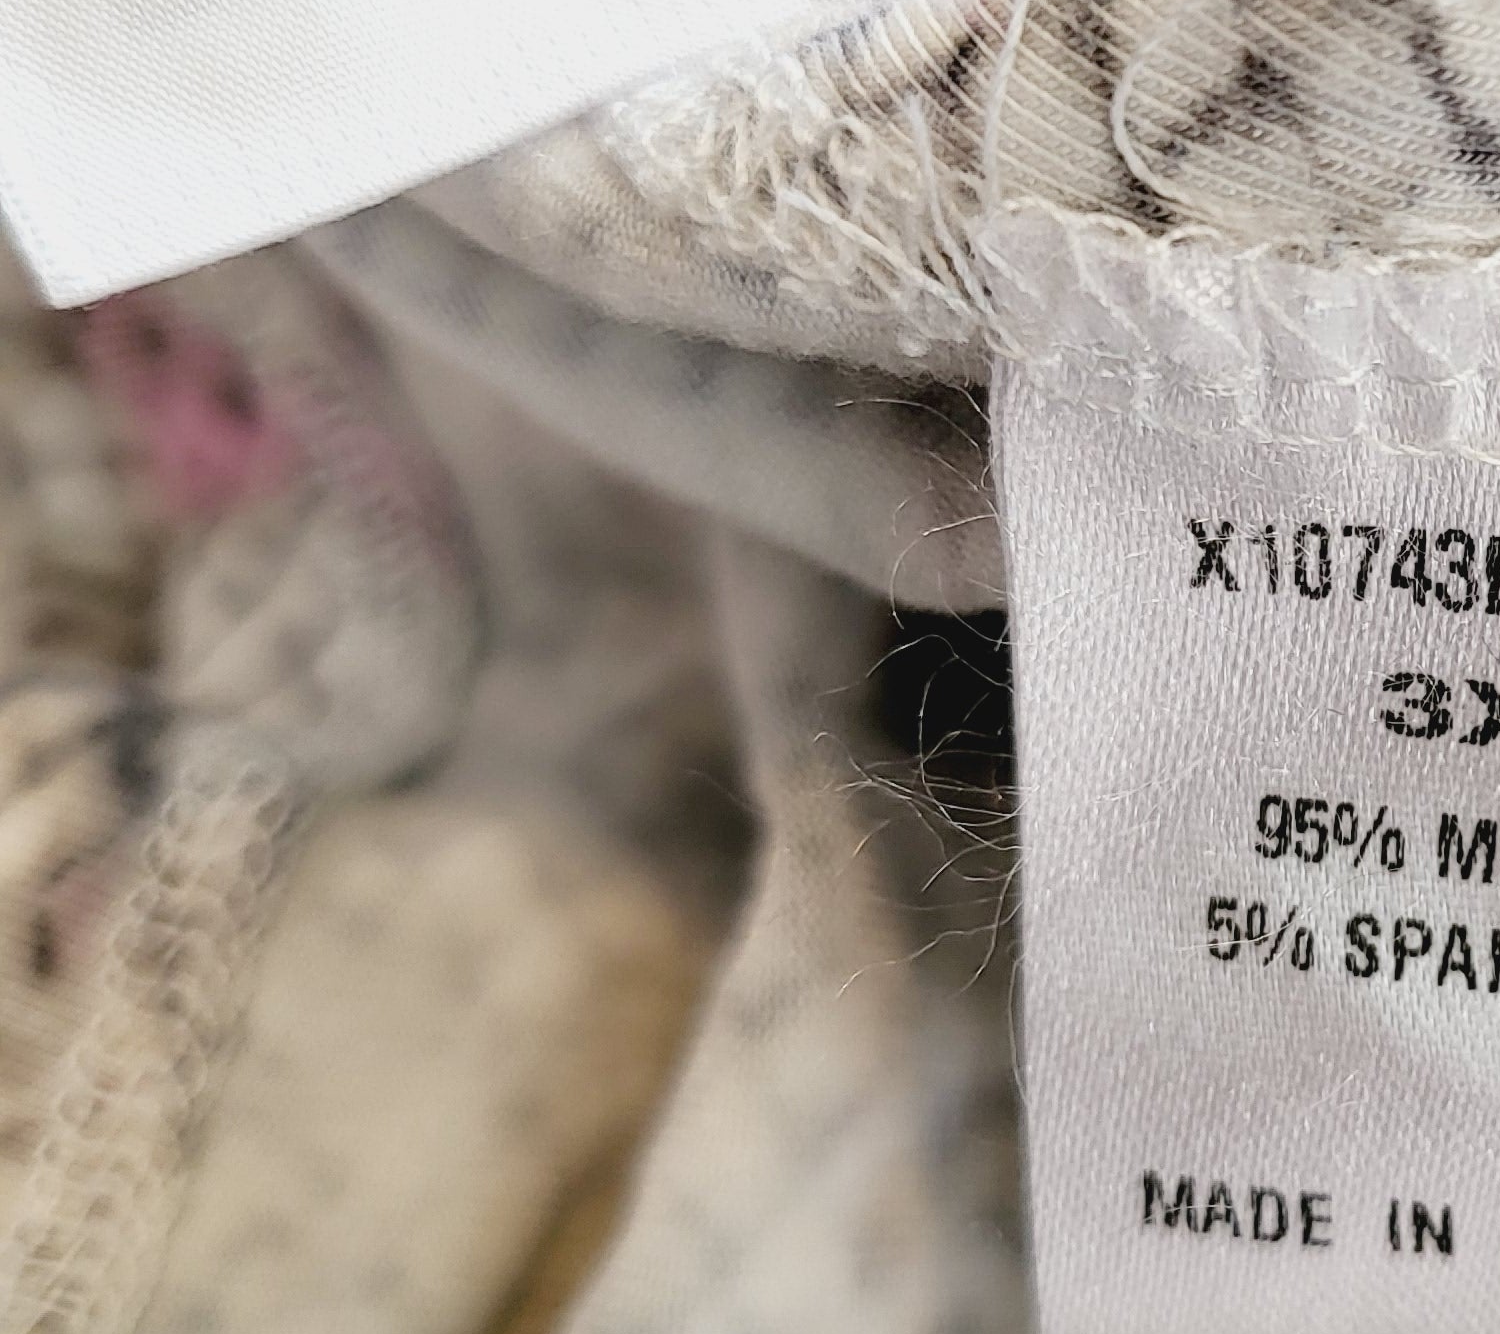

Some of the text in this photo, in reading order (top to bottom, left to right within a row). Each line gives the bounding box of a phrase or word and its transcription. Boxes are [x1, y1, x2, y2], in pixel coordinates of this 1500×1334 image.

[1255, 793, 1406, 874] 95%
[1206, 896, 1315, 973] 5%
[1142, 1170, 1334, 1248] MADE
[1387, 1197, 1454, 1257] IN
